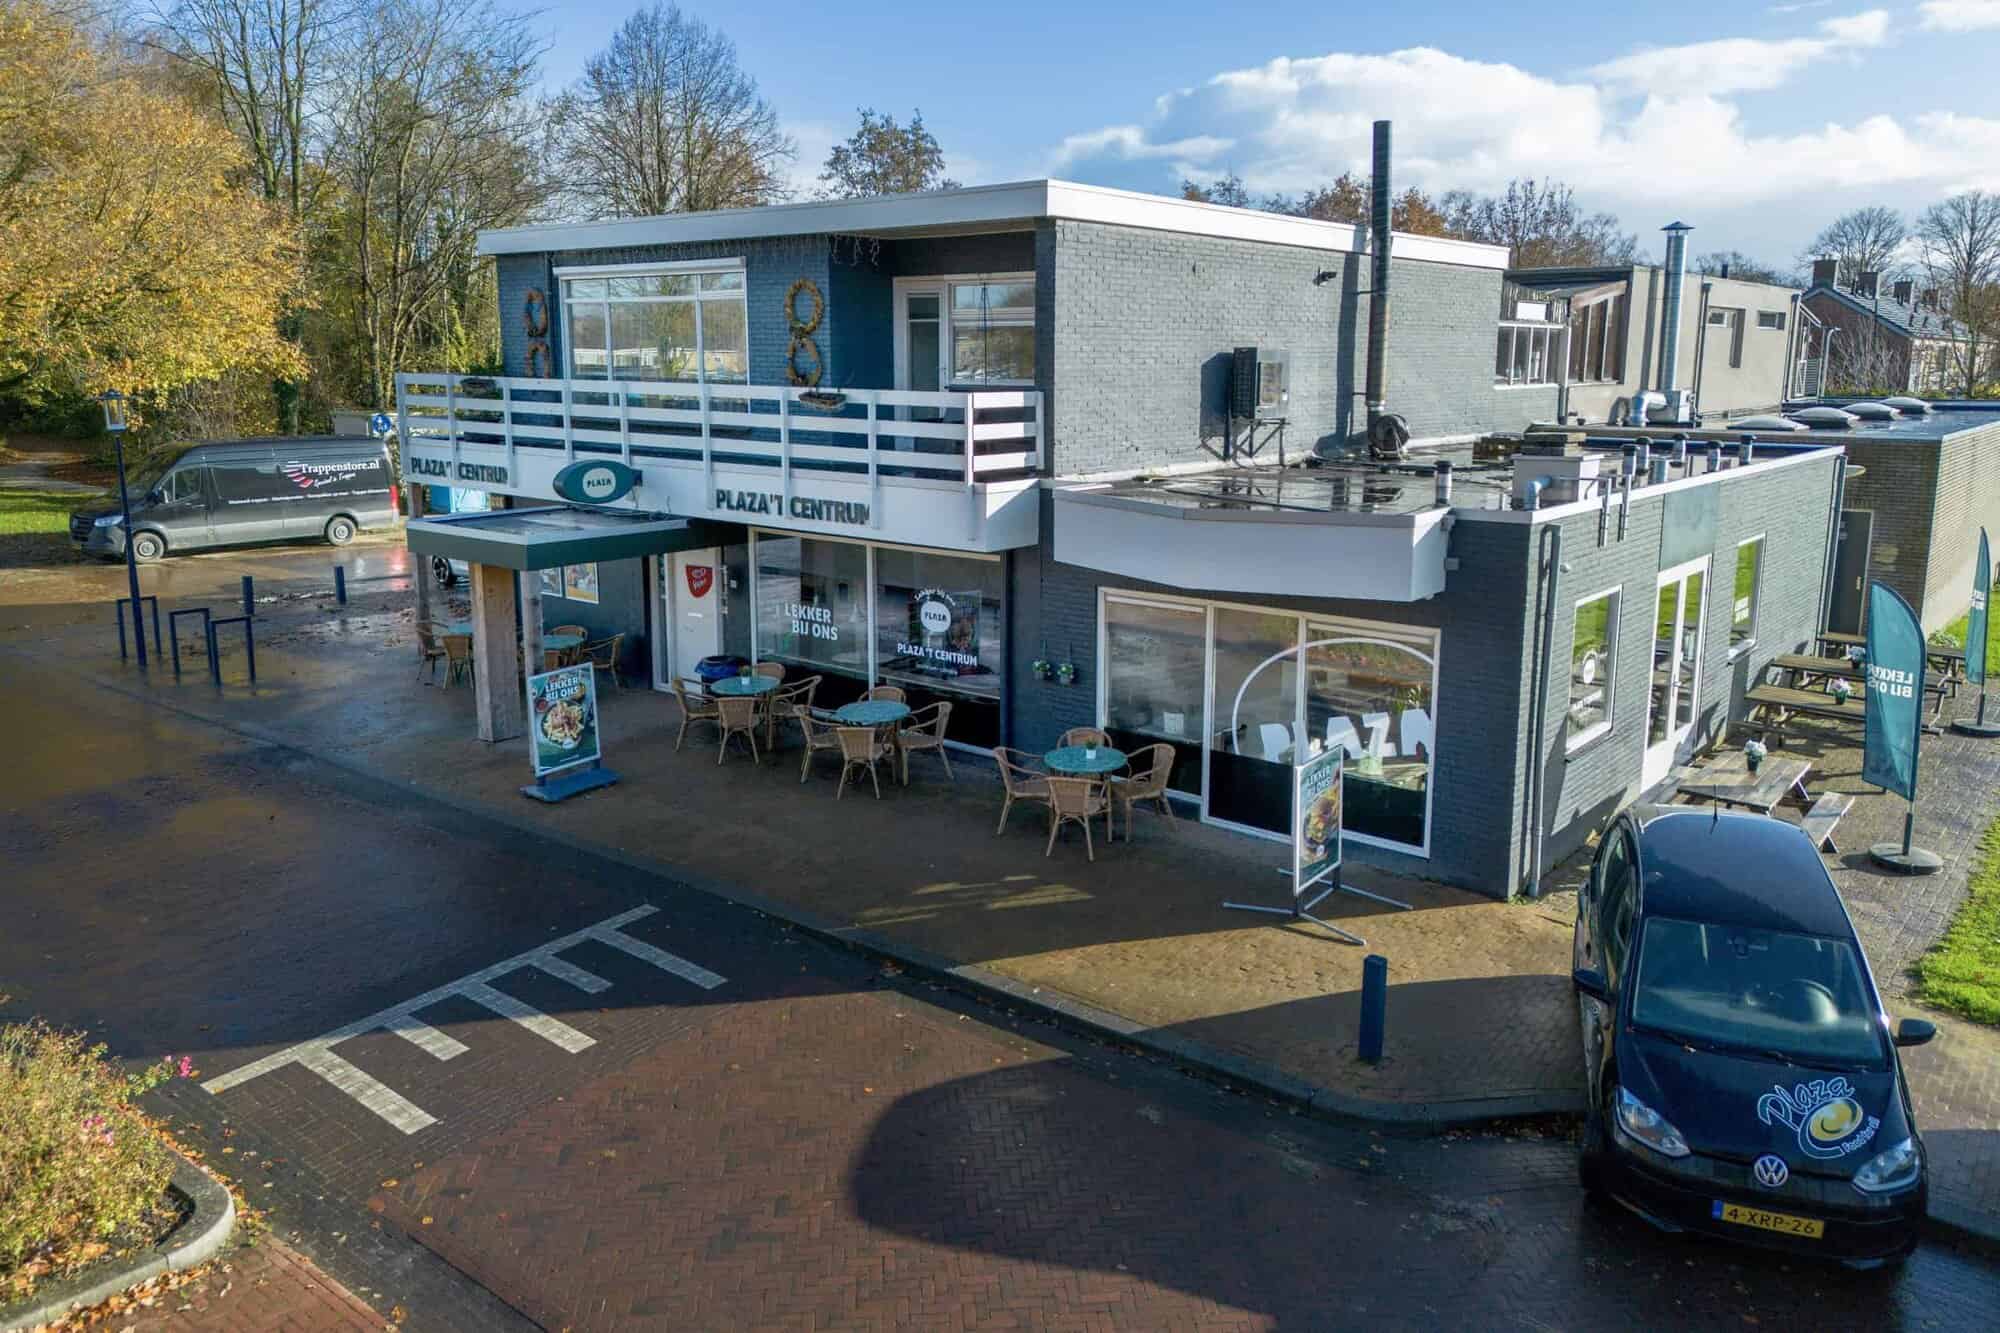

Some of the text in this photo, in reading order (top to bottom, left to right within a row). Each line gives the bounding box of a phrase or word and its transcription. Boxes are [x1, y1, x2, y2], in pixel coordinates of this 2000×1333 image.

[301, 459, 379, 475] Trappenstore.nl
[586, 478, 612, 488] PLAZA
[790, 496, 870, 525] CENTRUM
[784, 603, 831, 623] LEKKER
[791, 619, 838, 641] BIJ ONS
[935, 650, 977, 666] CENTRUM
[545, 676, 578, 693] LEKKER
[1259, 708, 1432, 766] PLAZA
[1757, 1076, 1855, 1131] Plaza
[1728, 1207, 1816, 1234] 4-XRP-26
